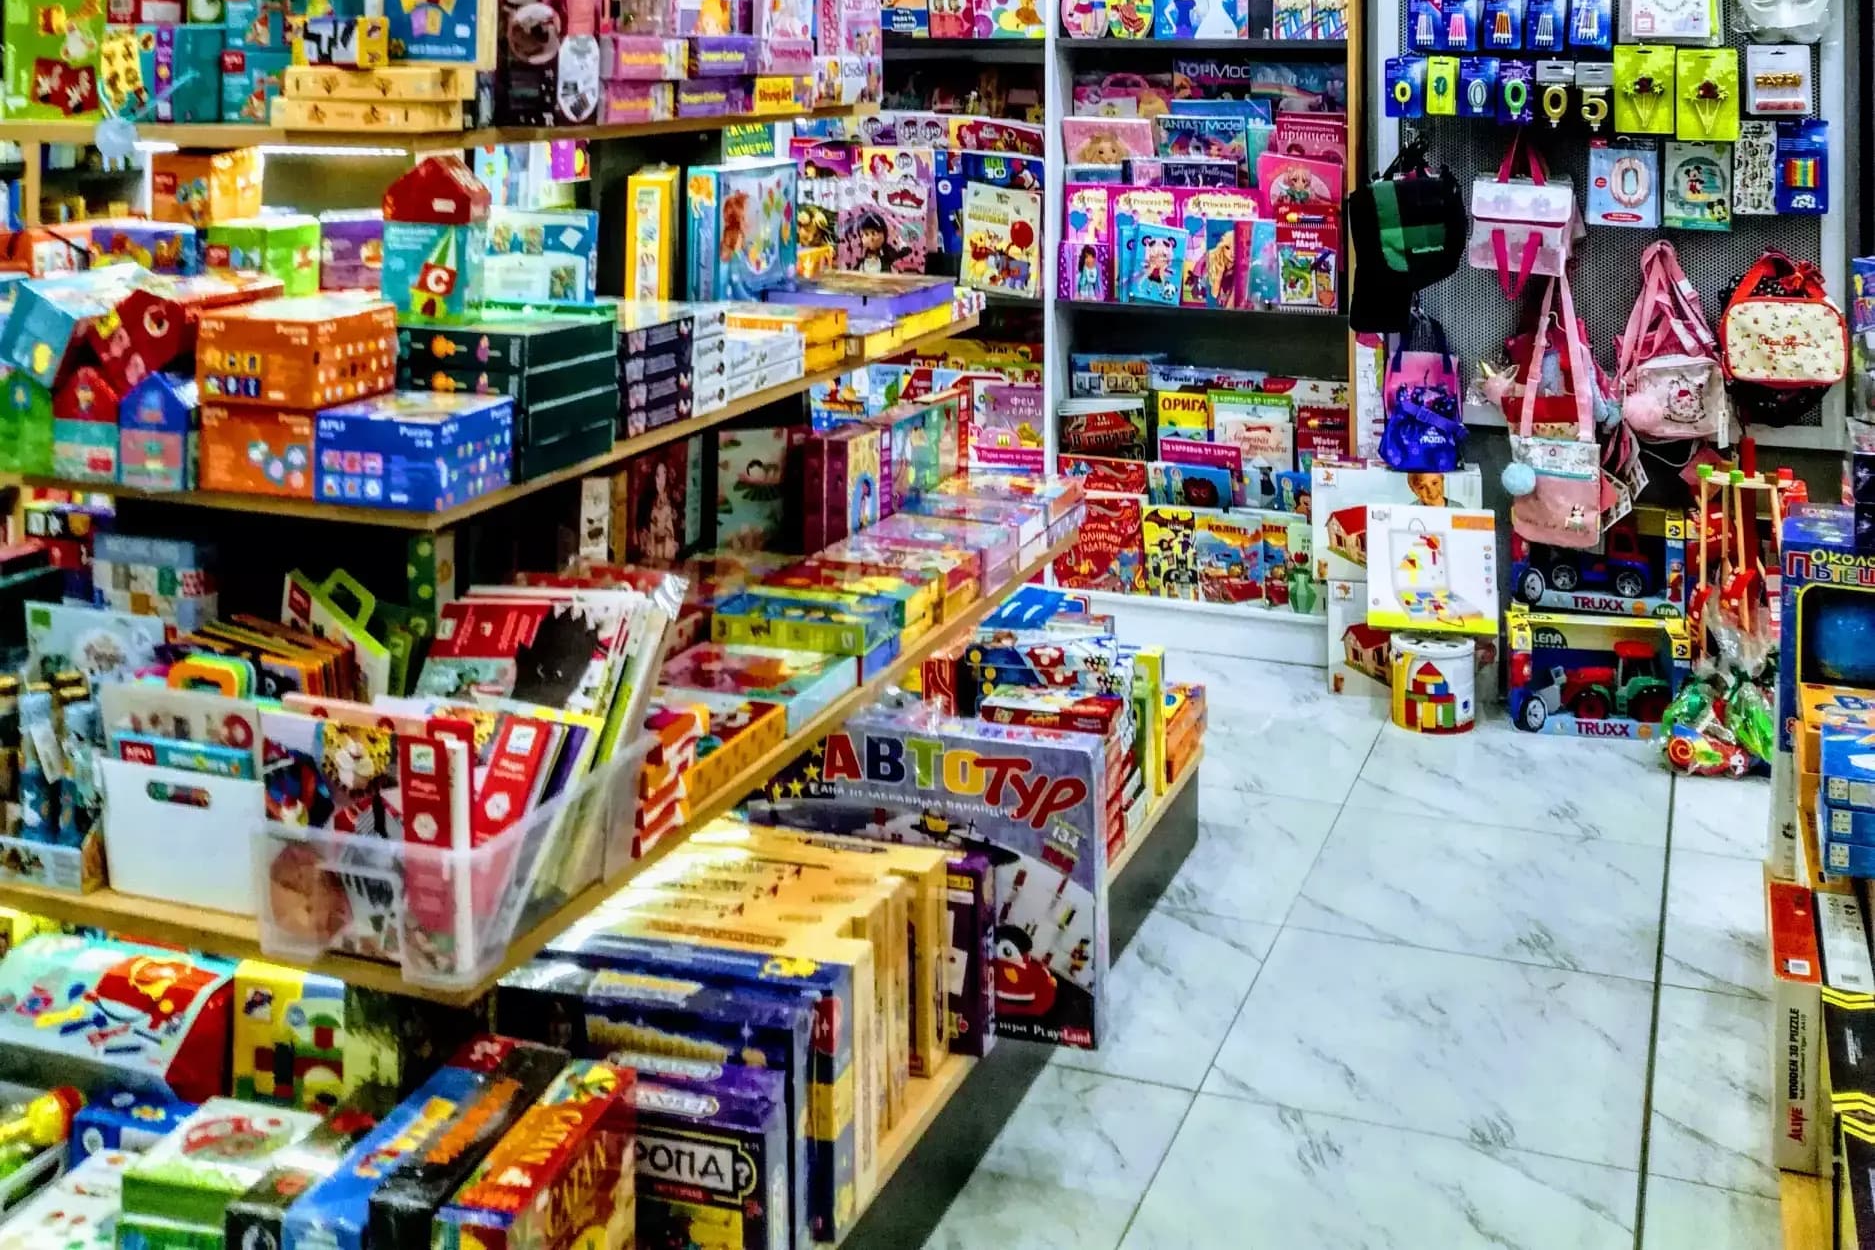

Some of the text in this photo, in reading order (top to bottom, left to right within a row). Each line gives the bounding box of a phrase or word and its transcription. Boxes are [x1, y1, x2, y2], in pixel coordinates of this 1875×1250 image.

[1581, 87, 1609, 122] 5
[1291, 231, 1319, 240] Water
[1295, 239, 1323, 250] Magic
[1572, 595, 1625, 612] TRUXX
[1656, 607, 1678, 617] LENA
[1533, 632, 1562, 644] LENA
[1575, 721, 1630, 738] TRUXX
[1789, 1007, 1800, 1040] PUZZLE
[1788, 1058, 1799, 1100] WOODEN
